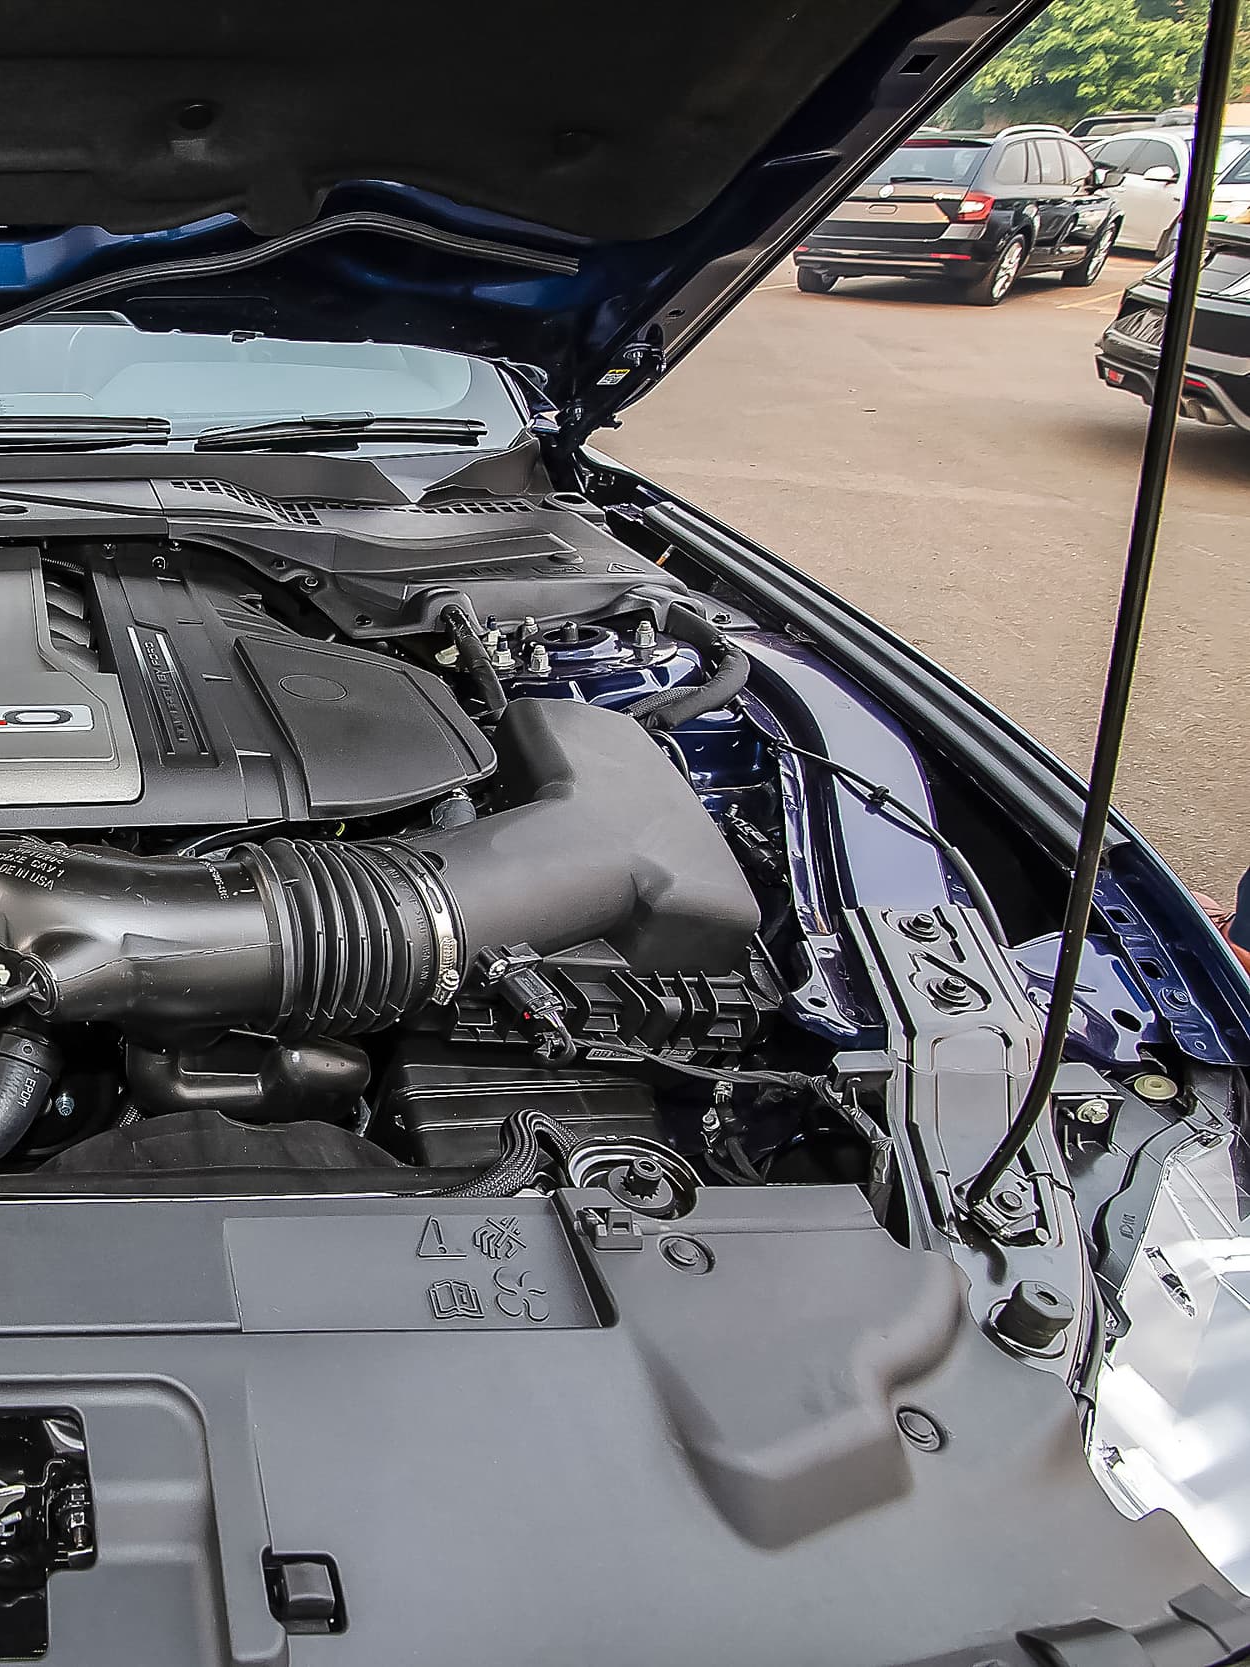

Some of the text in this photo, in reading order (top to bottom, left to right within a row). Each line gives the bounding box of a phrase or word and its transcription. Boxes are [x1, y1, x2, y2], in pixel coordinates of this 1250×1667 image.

[15, 867, 31, 879] IN
[29, 872, 55, 891] USA
[17, 1077, 37, 1108] EPDM
